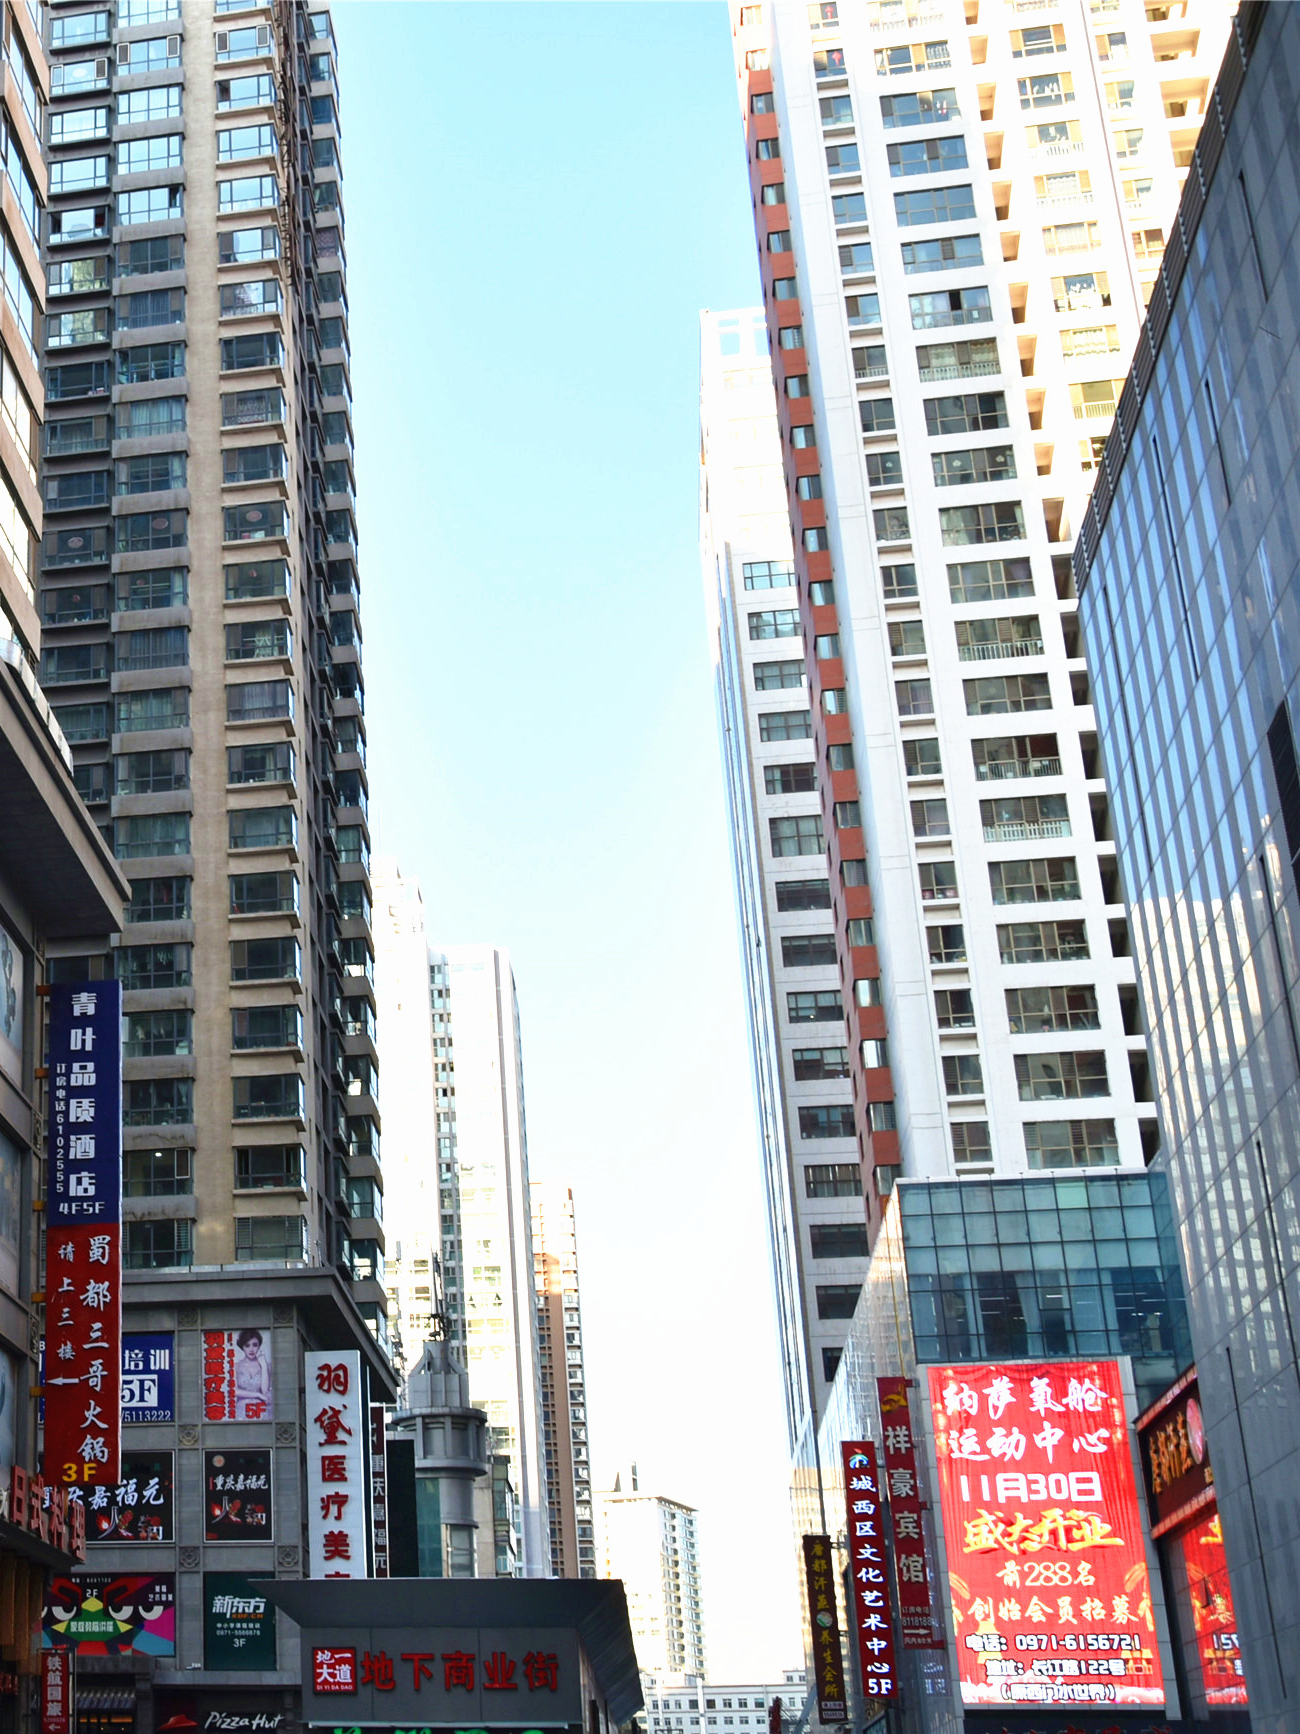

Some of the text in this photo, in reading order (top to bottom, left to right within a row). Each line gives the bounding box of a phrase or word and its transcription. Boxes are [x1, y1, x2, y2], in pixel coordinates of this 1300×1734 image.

[68, 992, 98, 1198] 青叶品质酒店
[58, 1201, 105, 1216] 4F5F
[56, 1242, 77, 1361] 请上三楼
[78, 1234, 112, 1465] 蜀都三哥火锅
[244, 1402, 267, 1420] 5F
[949, 1420, 1111, 1465] 运动中心
[61, 1462, 99, 1483] 3F
[314, 1362, 353, 1579] 羽黛医疗美
[960, 1471, 1103, 1504] 11月30日
[11, 1464, 87, 1562] 日式料理
[884, 1425, 925, 1584] 祥豪宾馆
[962, 1507, 1126, 1556] 盛大开业
[849, 1476, 893, 1696] 城西区文化艺术中心 5F
[996, 1560, 1096, 1590] 前288名
[212, 1595, 267, 1619] 新东方
[967, 1595, 1139, 1625] 创始会员招募
[233, 1638, 247, 1648] 3F
[316, 1664, 352, 1683] 大道
[360, 1650, 560, 1692] 地下商业街
[205, 1711, 286, 1730] Pizza Hut
